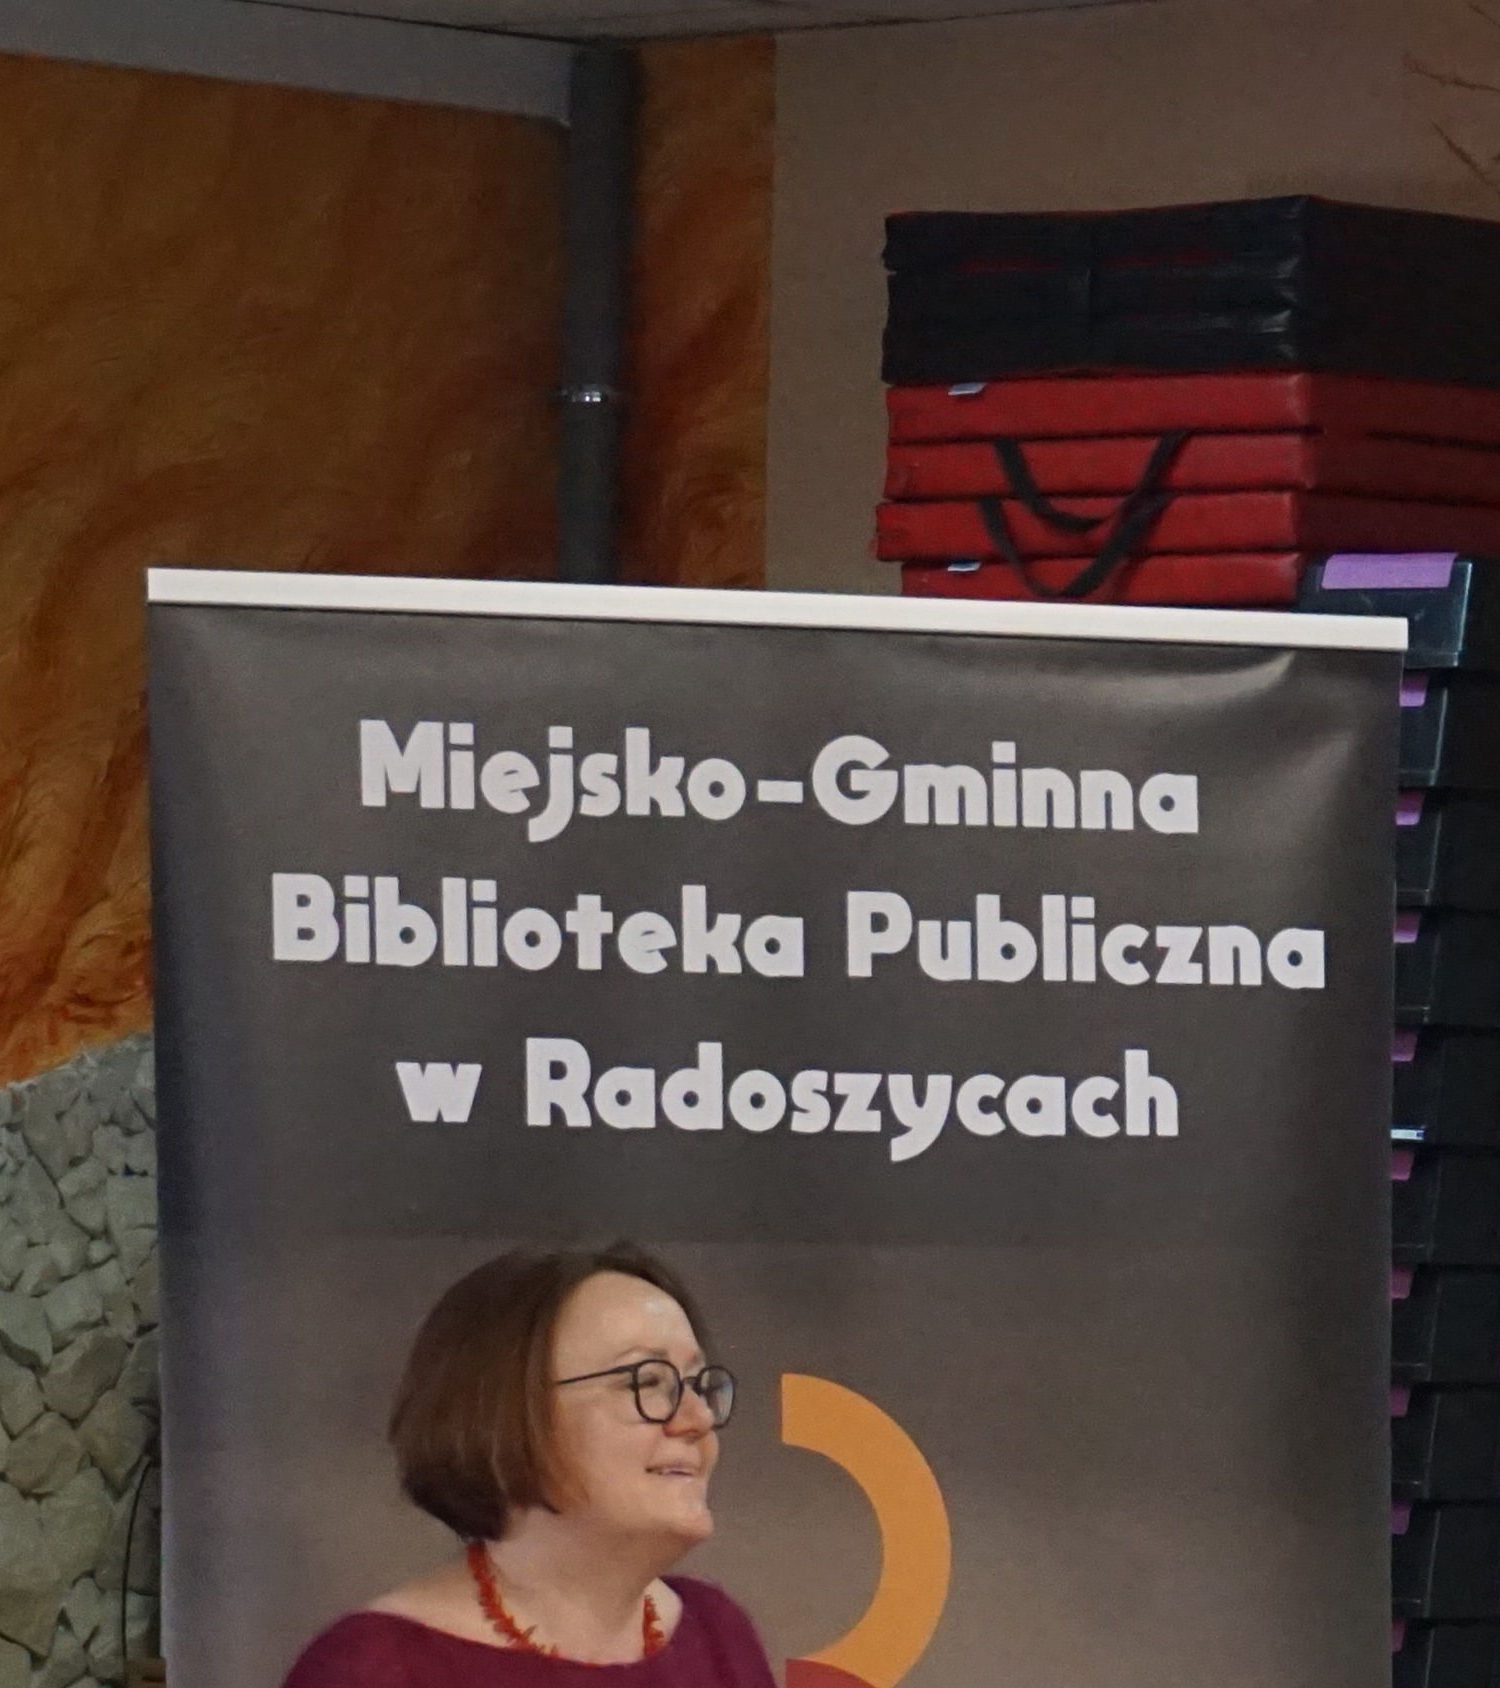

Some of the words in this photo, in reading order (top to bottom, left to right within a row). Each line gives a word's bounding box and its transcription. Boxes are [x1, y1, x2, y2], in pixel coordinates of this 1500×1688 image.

[359, 718, 1199, 843] Miejsko-Gminna
[272, 872, 805, 979] Biblioteka
[846, 889, 1327, 991] Publiczna
[395, 1059, 483, 1125] w
[525, 1037, 1181, 1163] Radoszycach
